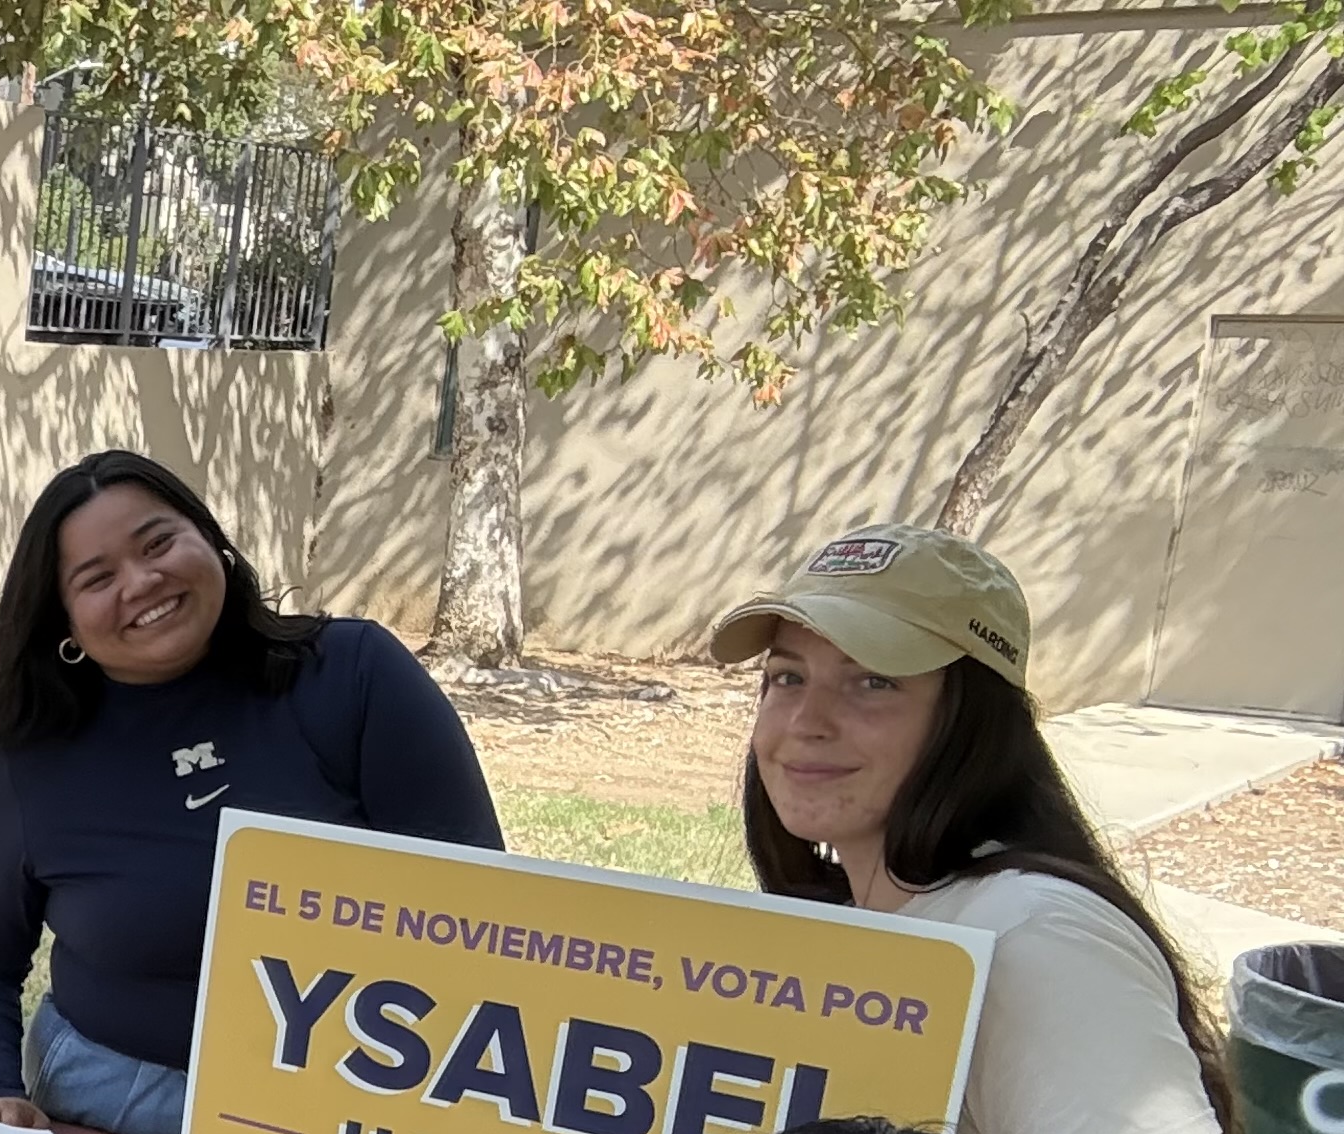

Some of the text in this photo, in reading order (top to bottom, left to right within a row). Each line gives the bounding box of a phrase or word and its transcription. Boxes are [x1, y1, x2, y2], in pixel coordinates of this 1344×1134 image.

[245, 880, 932, 1036] EL 5 DE NOVIEMBRE, VOTA POR
